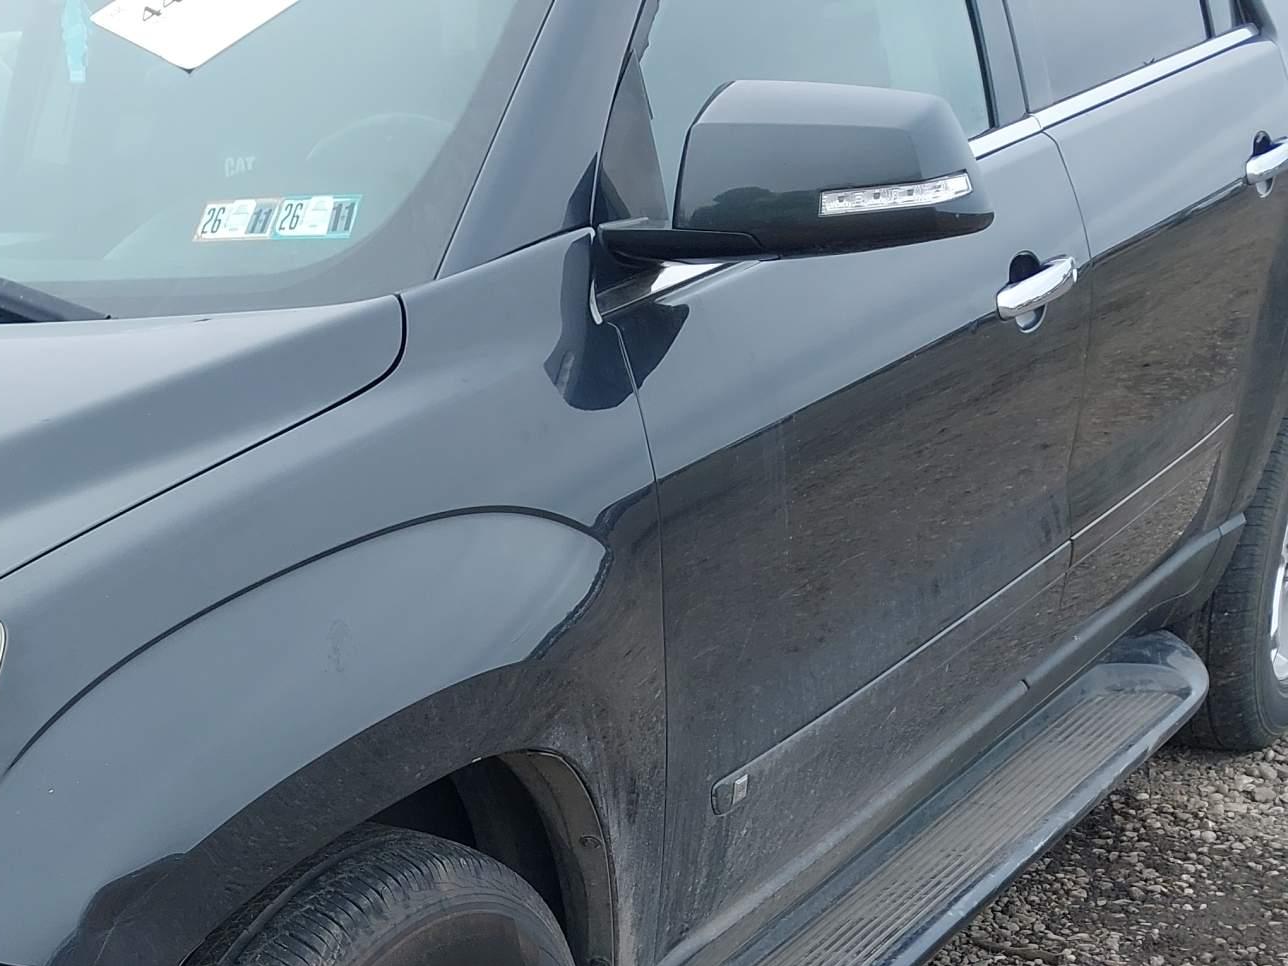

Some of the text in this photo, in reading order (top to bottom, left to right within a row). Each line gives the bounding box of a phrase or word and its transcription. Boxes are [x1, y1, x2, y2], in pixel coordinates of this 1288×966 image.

[224, 156, 257, 177] CAT
[201, 207, 226, 234] 26
[248, 208, 273, 234] 11
[278, 202, 304, 231] 26
[331, 202, 356, 232] 11
